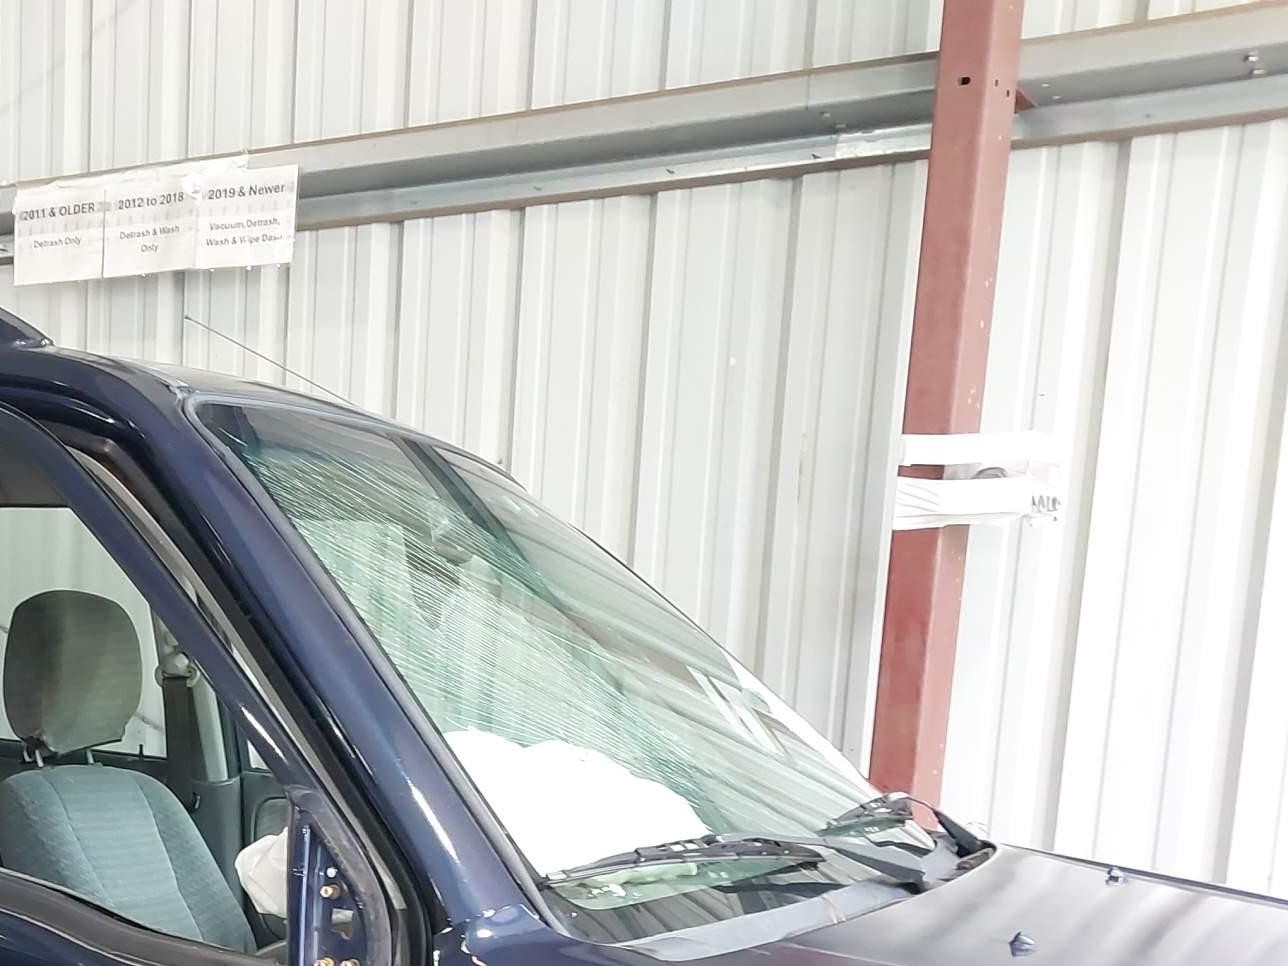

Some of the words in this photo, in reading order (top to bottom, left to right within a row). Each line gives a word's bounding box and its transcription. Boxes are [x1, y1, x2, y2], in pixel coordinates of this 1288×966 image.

[208, 186, 236, 200] 2019
[238, 185, 246, 197] &
[248, 183, 285, 197] Newer
[118, 196, 144, 210] 2012
[146, 196, 158, 208] to
[159, 191, 185, 206] 2018
[23, 207, 46, 221] 2011
[48, 206, 57, 218] &
[59, 202, 95, 217] OLDER
[120, 229, 151, 240] Detrash
[152, 227, 158, 236] &
[159, 224, 180, 235] Wash
[209, 222, 246, 232] Vacuum,
[64, 235, 81, 247] Only
[206, 237, 230, 247] Wash
[231, 236, 238, 245] &
[140, 244, 159, 253] Only
